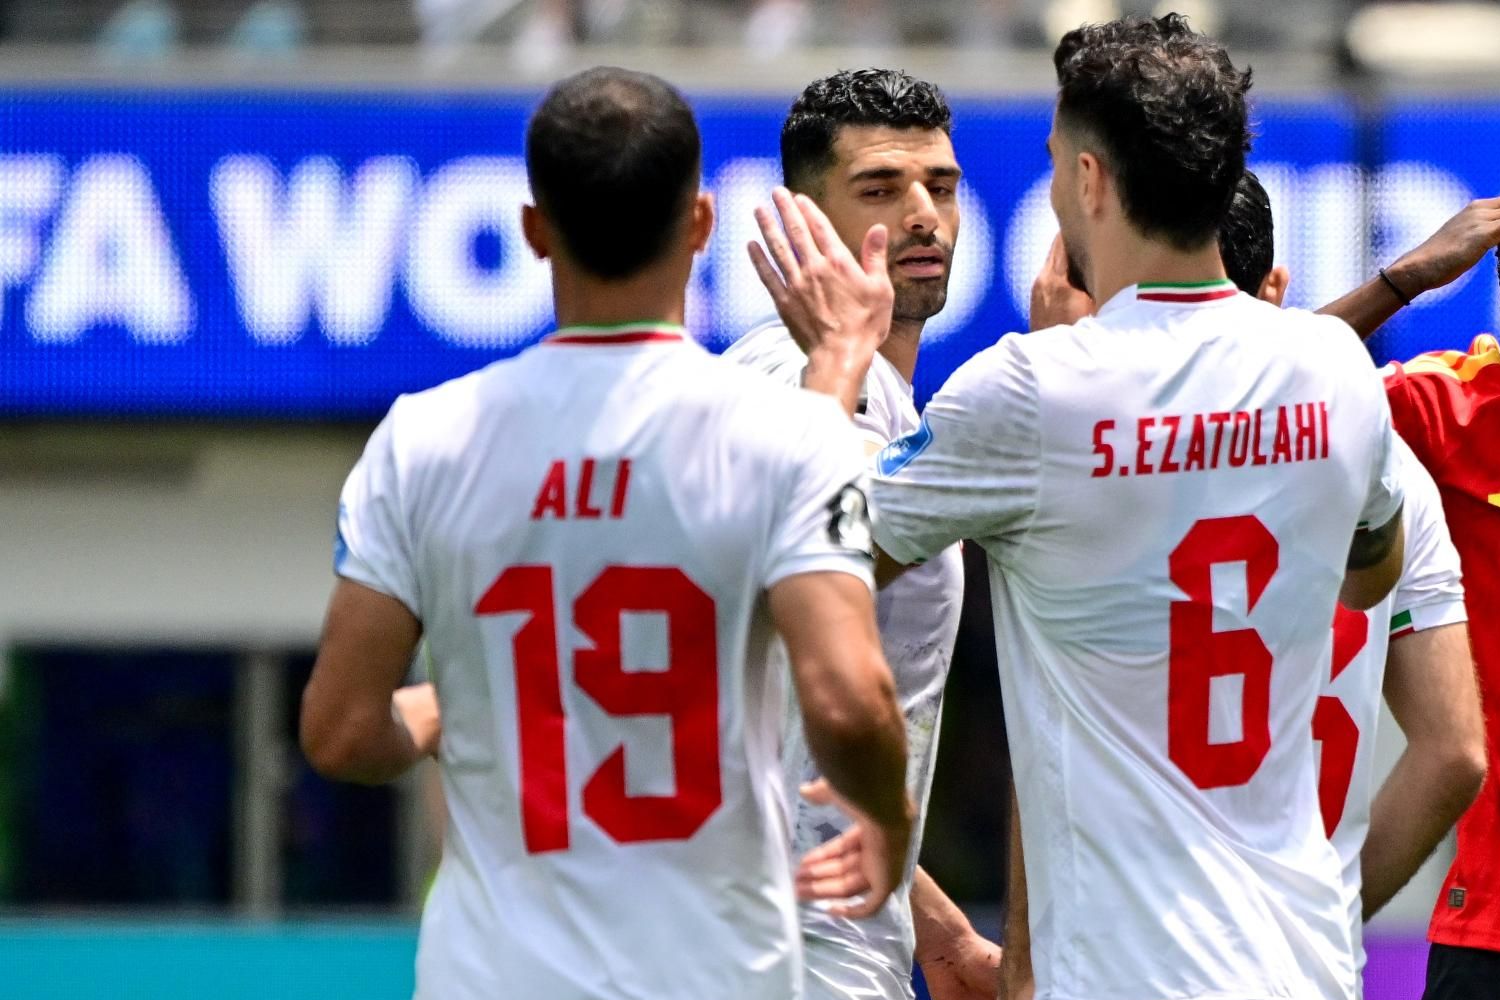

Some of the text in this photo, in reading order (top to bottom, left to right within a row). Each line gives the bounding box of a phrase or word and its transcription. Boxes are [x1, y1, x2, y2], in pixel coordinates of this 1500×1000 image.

[531, 457, 632, 520] ALI
[1091, 401, 1329, 478] S.EZATOLAHI
[472, 562, 723, 857] 19
[1167, 514, 1280, 791] 6
